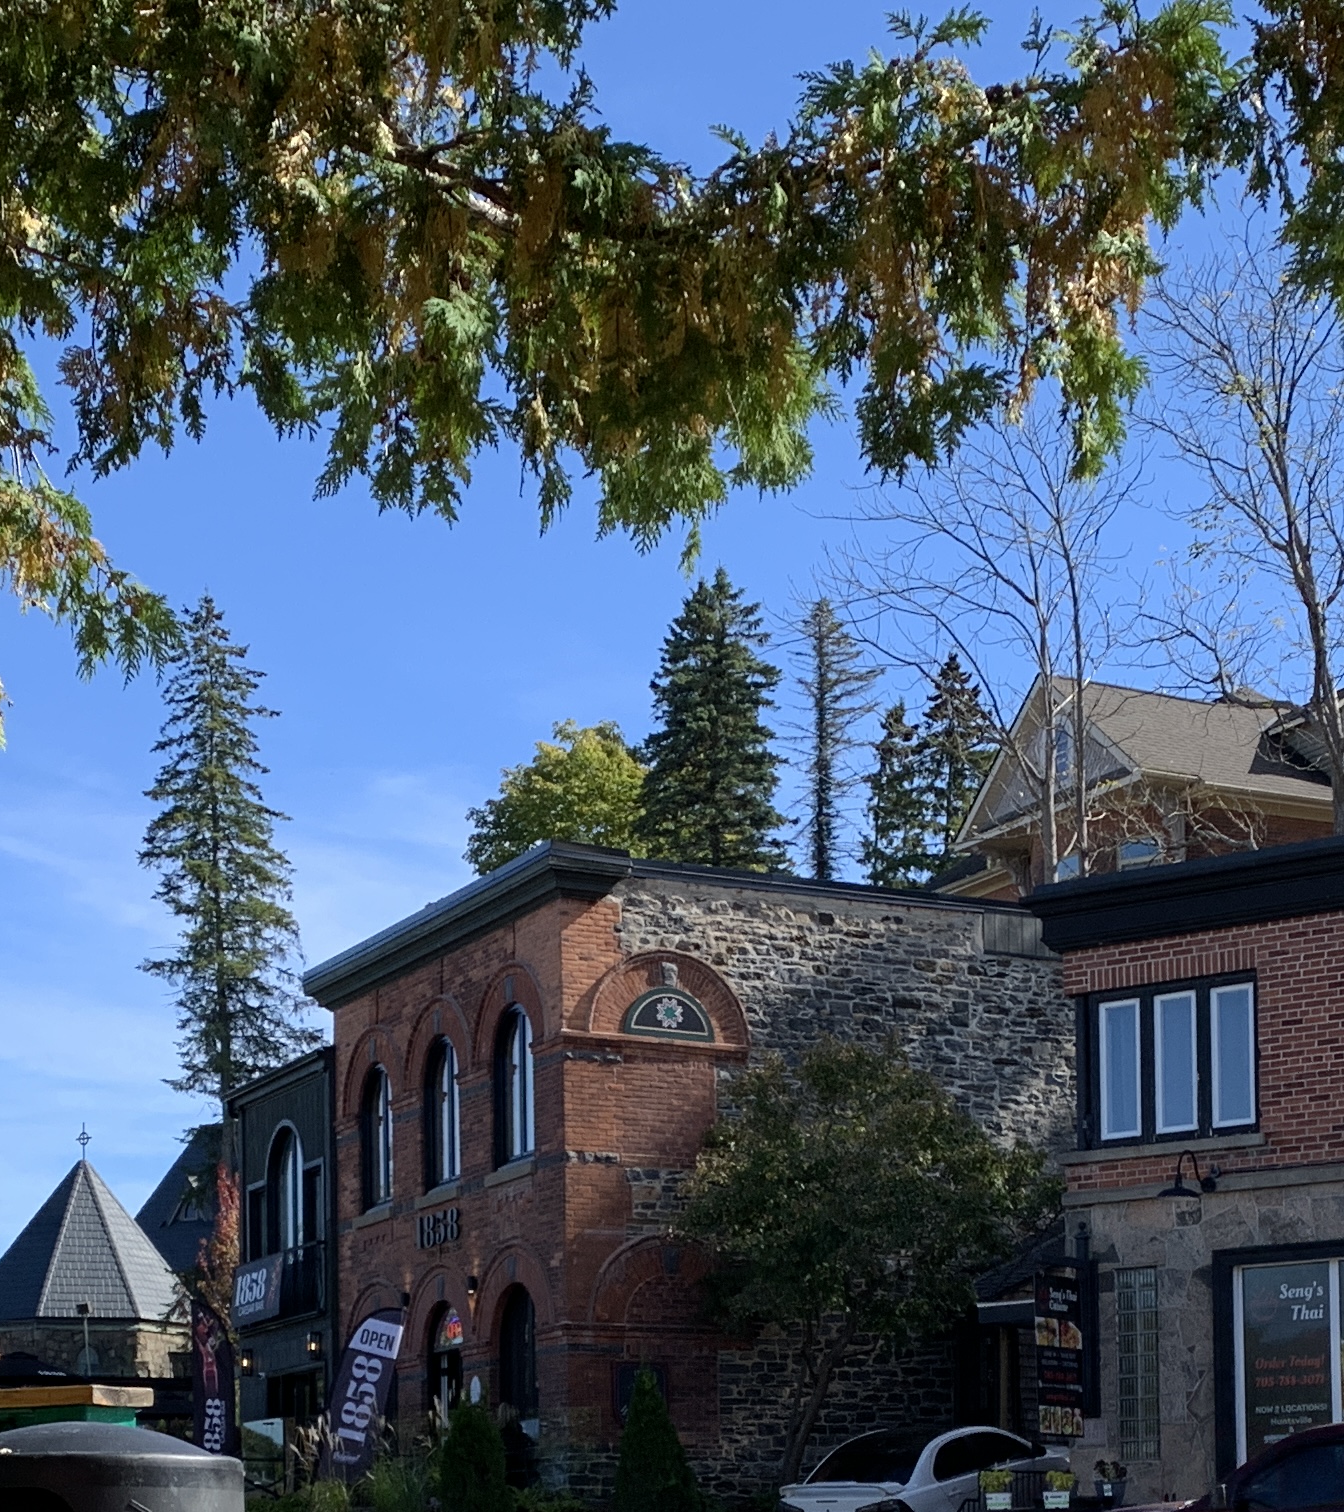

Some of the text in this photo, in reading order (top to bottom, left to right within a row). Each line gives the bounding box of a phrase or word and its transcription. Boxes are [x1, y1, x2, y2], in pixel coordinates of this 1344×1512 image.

[415, 1207, 460, 1251] 1858
[234, 1268, 267, 1308] 1858
[1279, 1281, 1324, 1301] Seng's
[1290, 1303, 1324, 1321] Thai
[360, 1328, 396, 1352] OPEN
[1255, 1356, 1286, 1370] Order
[336, 1354, 383, 1447] 1858
[1255, 1405, 1273, 1415] NOW
